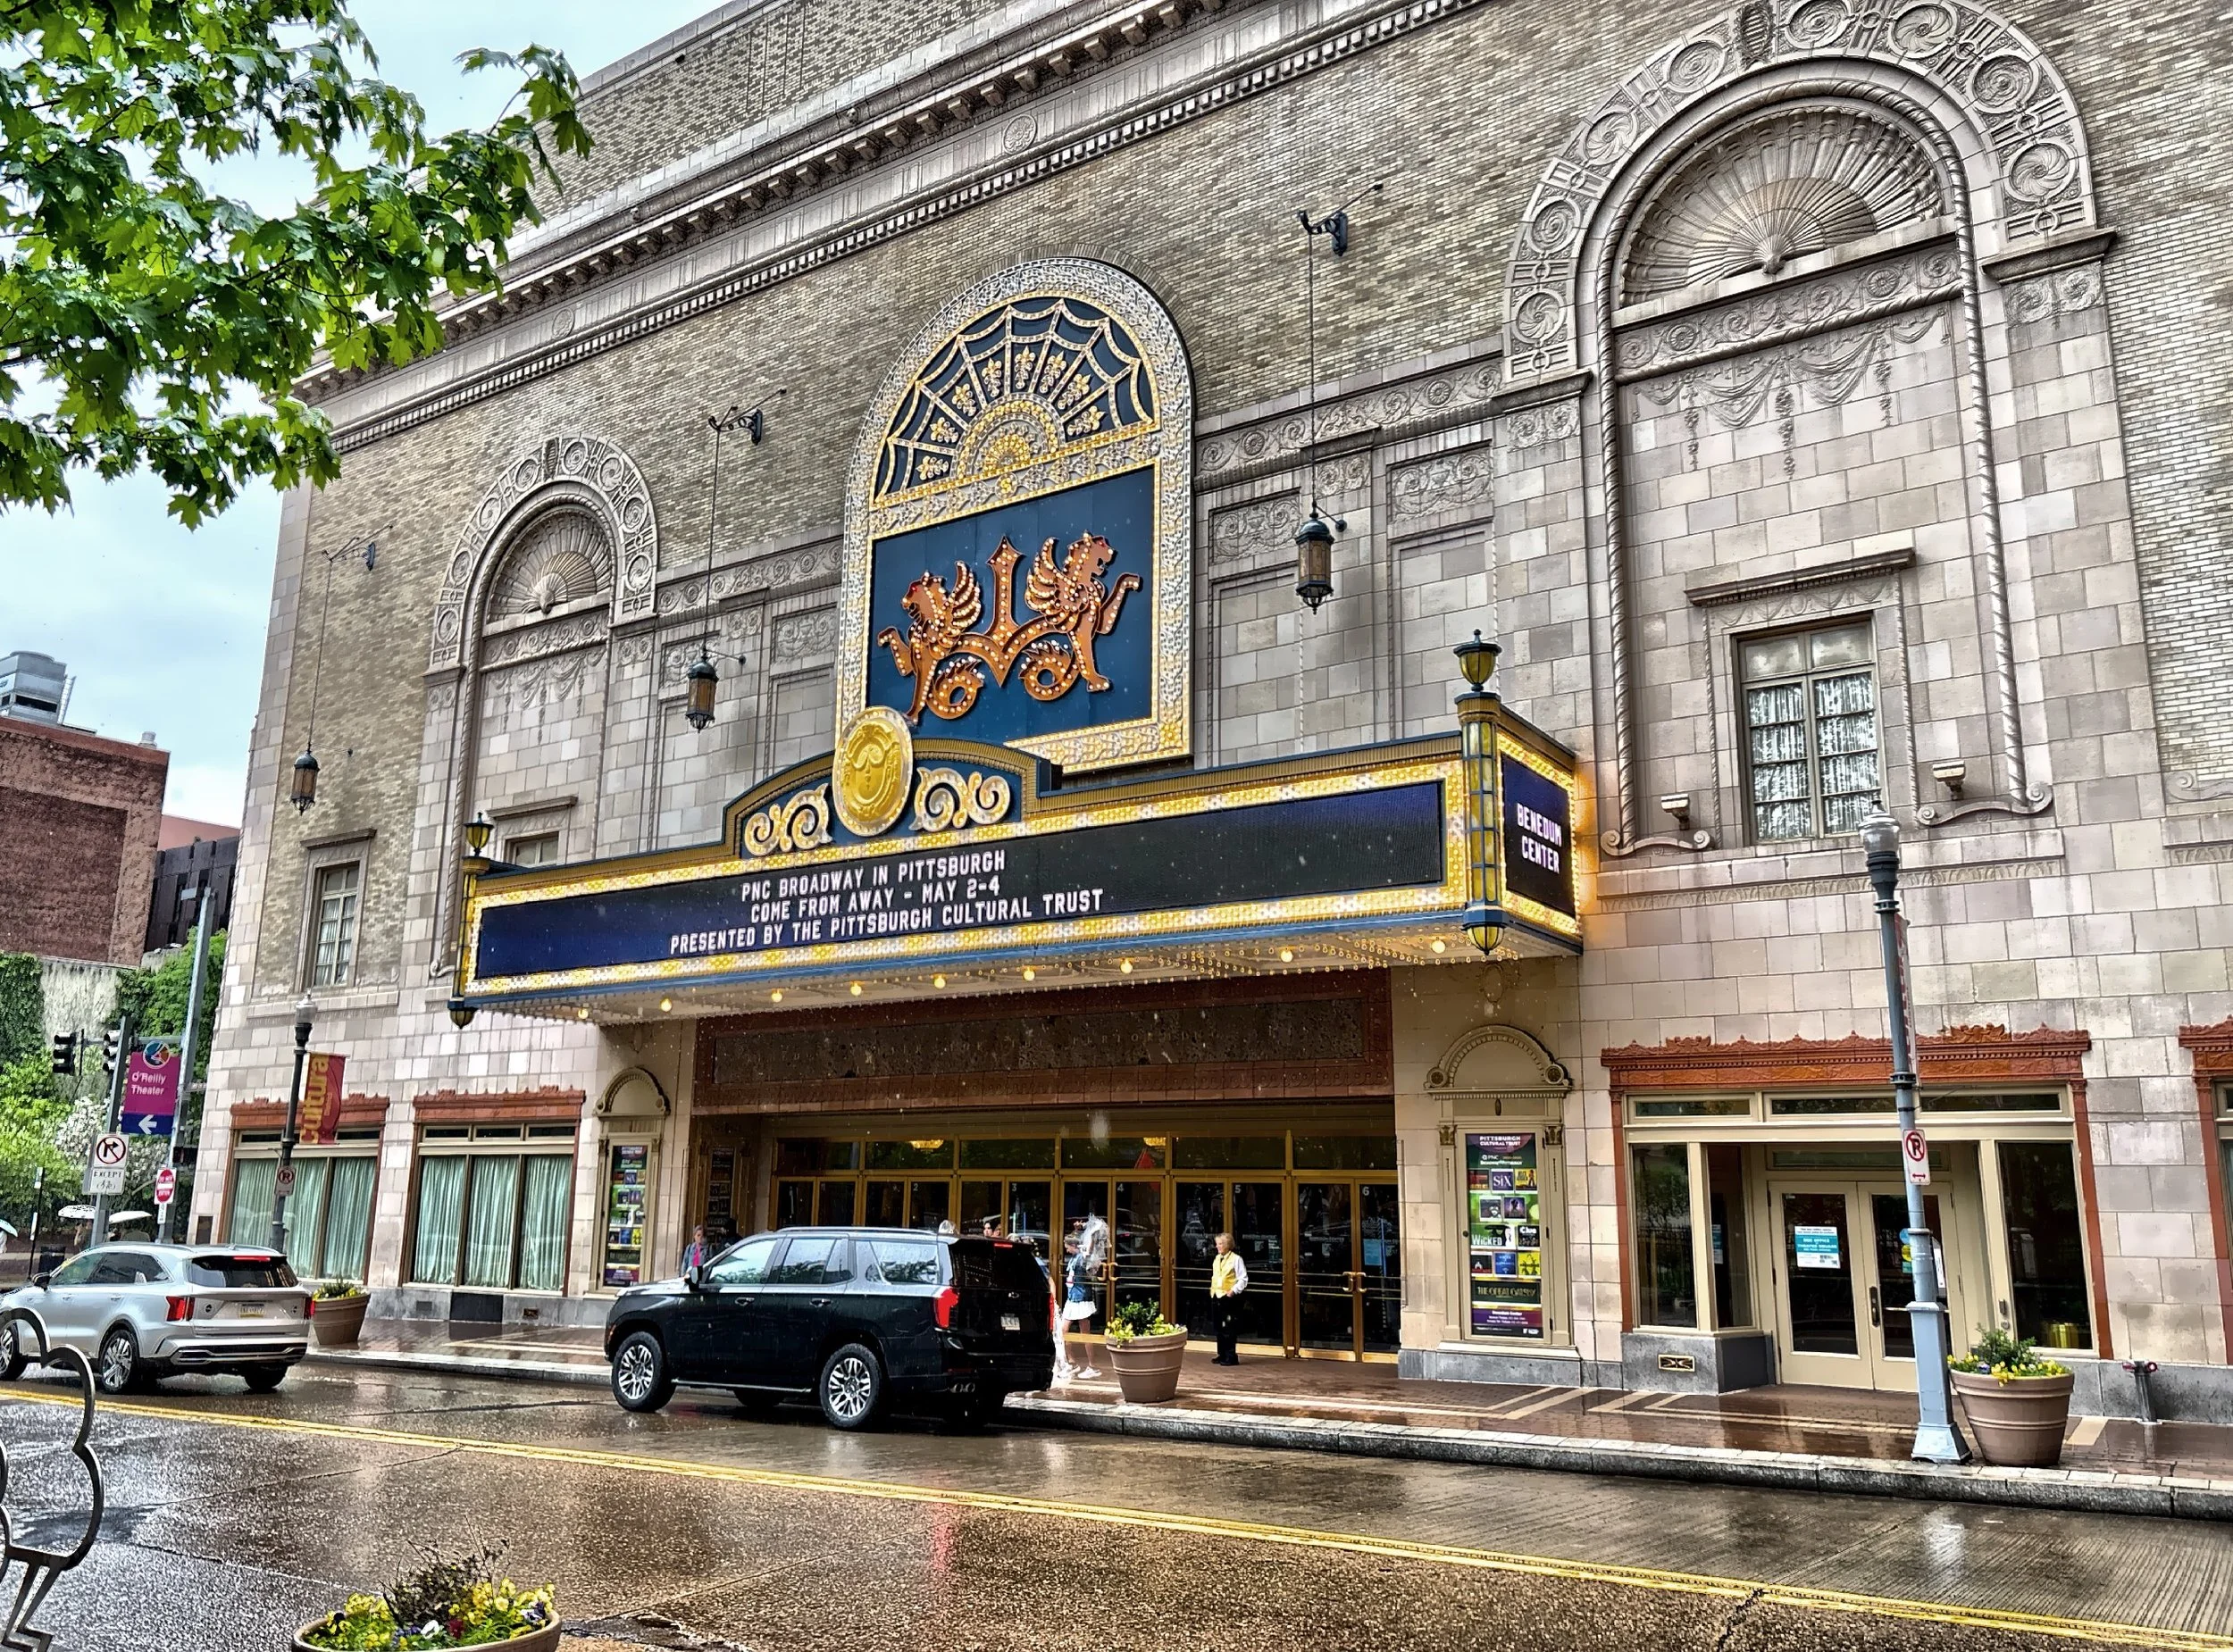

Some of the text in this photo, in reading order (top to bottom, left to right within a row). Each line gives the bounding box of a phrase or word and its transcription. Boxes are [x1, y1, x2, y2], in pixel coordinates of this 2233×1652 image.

[1517, 803, 1562, 847] BENEDUM
[1522, 835, 1560, 874] CENTER
[741, 849, 1006, 902] PNC BROADWAY IN PITTSBURGH
[751, 900, 790, 923] COME
[799, 894, 841, 918] FROM
[848, 887, 894, 912] AWAY
[922, 880, 957, 905] MAY
[966, 875, 1000, 899] 2-4
[670, 889, 1104, 955] PRESENTED BY THE PITTSBURGH CULTURAL TRUST
[131, 1072, 167, 1085] O'Reilly
[130, 1085, 165, 1096] Theater
[913, 1183, 918, 1191] 2
[1012, 1183, 1017, 1192] 3
[1116, 1183, 1125, 1192] 4
[1234, 1185, 1242, 1194] 5
[1362, 1186, 1370, 1197] 6
